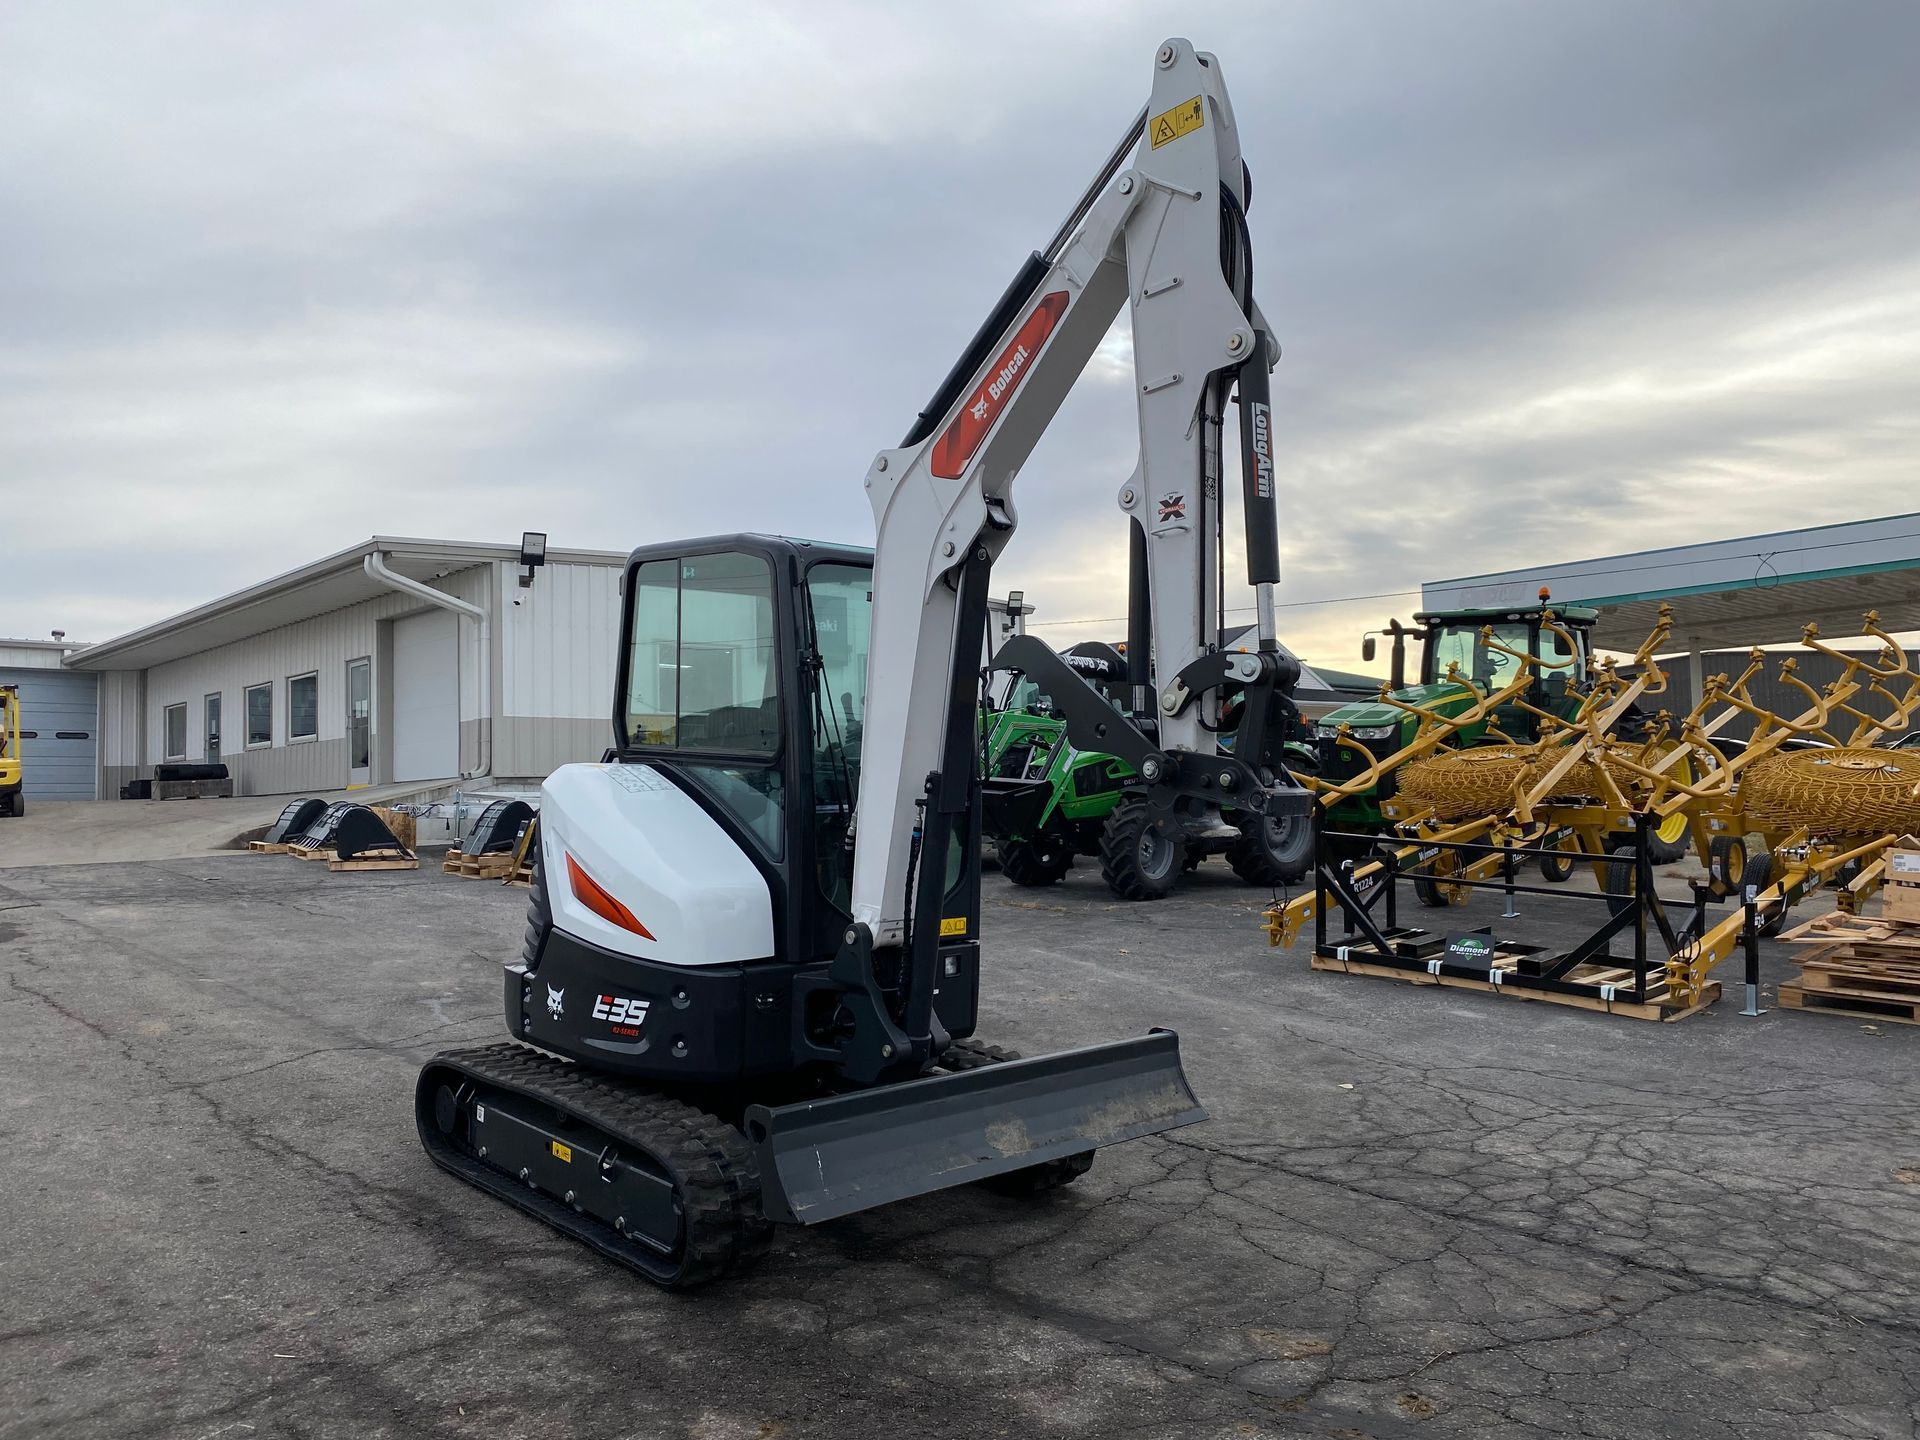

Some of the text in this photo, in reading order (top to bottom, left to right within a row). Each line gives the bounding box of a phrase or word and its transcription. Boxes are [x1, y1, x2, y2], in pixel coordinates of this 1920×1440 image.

[988, 344, 1029, 400] Bobcat
[1254, 402, 1273, 498] LongArm
[1354, 876, 1374, 893] R1224
[1449, 944, 1490, 955] Diamond
[592, 994, 650, 1026] E35
